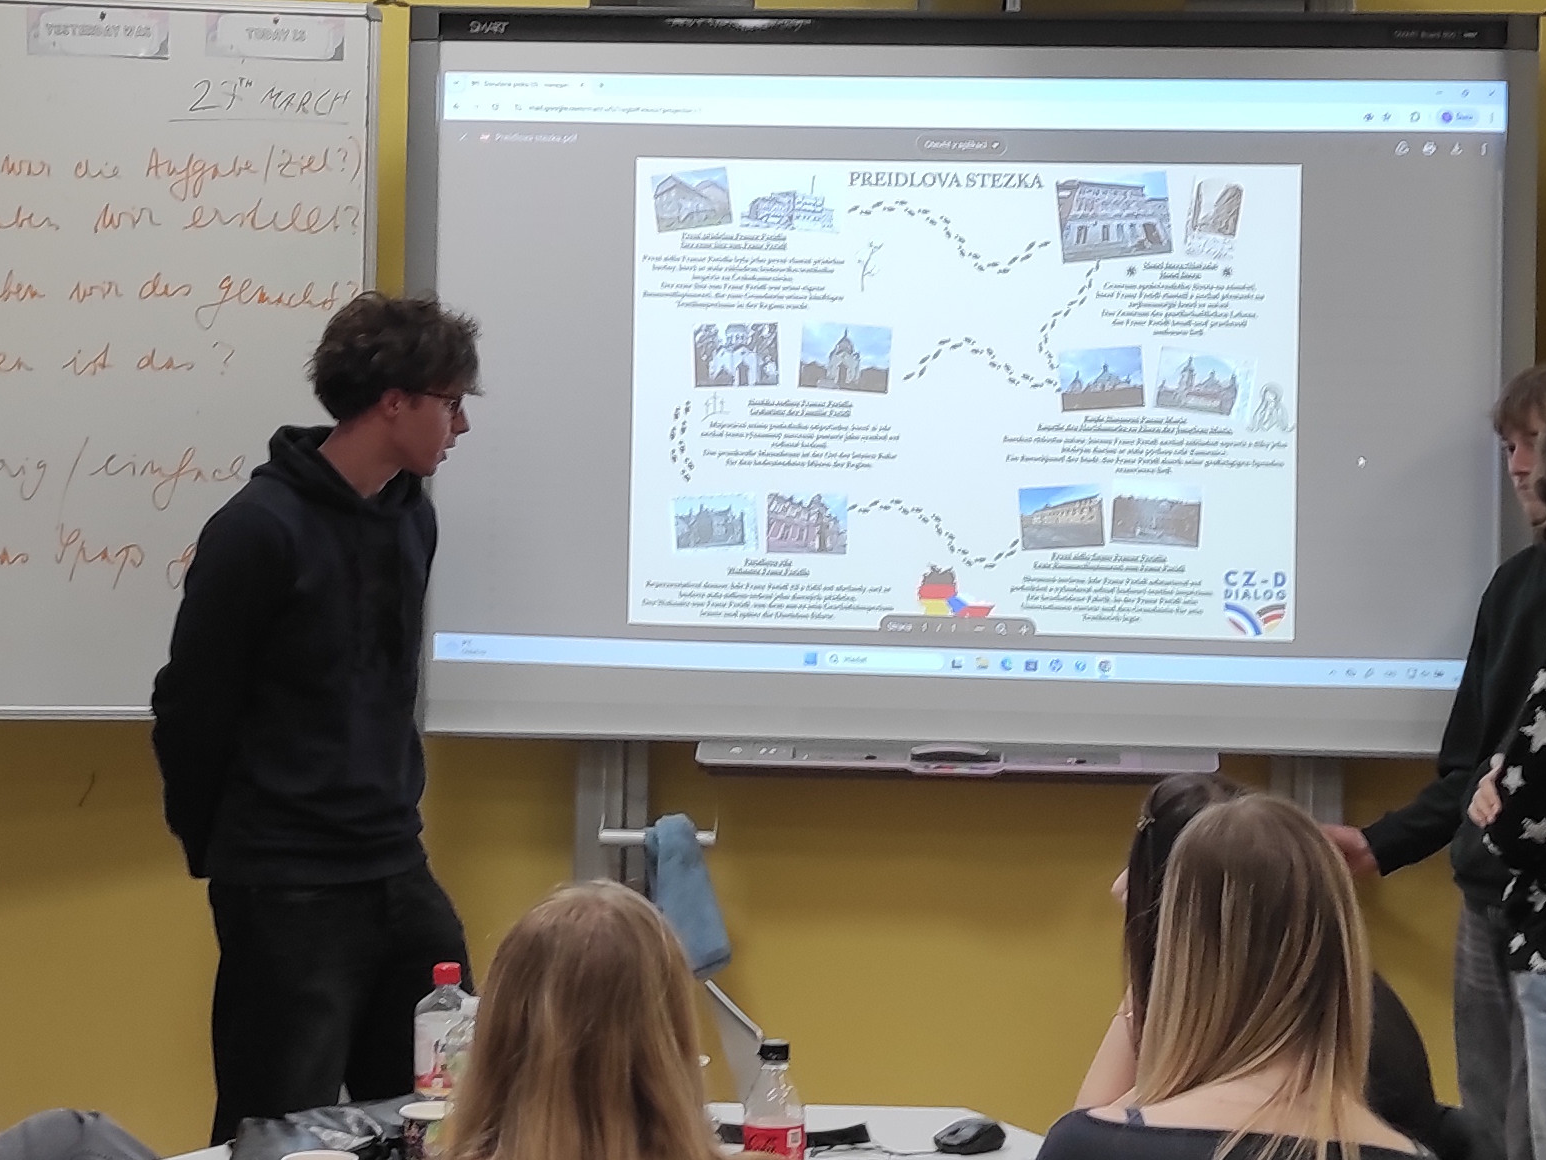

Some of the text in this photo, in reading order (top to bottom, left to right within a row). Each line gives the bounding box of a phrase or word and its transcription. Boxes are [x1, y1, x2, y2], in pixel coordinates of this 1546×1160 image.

[260, 86, 352, 116] MARCH
[74, 152, 121, 180] die
[848, 171, 1043, 188] PREIDLOVA STEZKA
[69, 276, 125, 304] wir
[61, 340, 113, 376] ist
[1223, 589, 1287, 601] DIALOG
